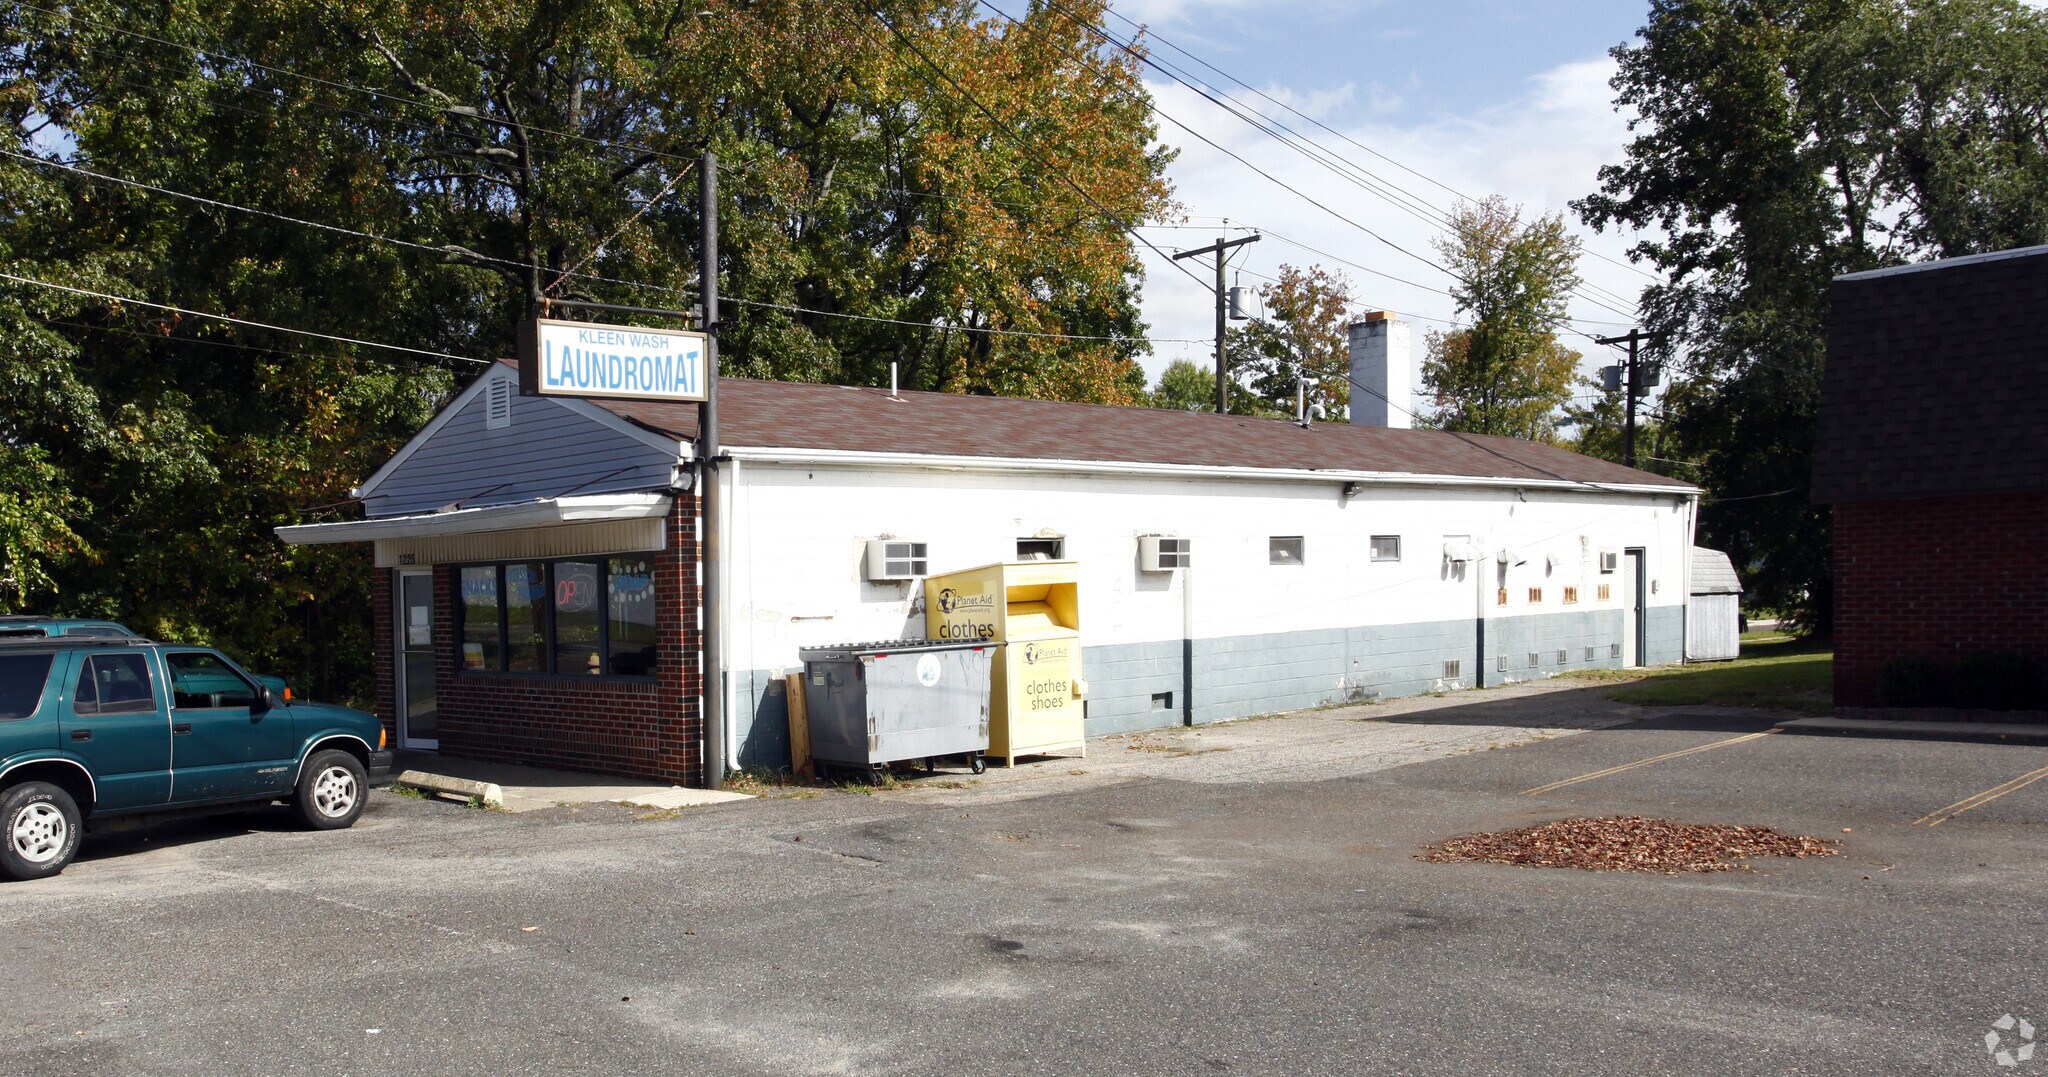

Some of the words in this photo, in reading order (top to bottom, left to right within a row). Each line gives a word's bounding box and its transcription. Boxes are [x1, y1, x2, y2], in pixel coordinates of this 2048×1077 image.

[578, 329, 625, 346] KLEEN
[629, 333, 669, 349] WASH
[546, 339, 699, 393] LAUNDROMAT
[399, 554, 416, 566] 1225
[557, 580, 593, 606] OPEN
[956, 595, 978, 605] Planet
[980, 594, 993, 605] Aid
[939, 618, 995, 638] clothes
[1039, 648, 1056, 657] Planet
[1057, 647, 1067, 655] Aid
[1026, 678, 1067, 695] clothes
[1031, 694, 1063, 711] shoes
